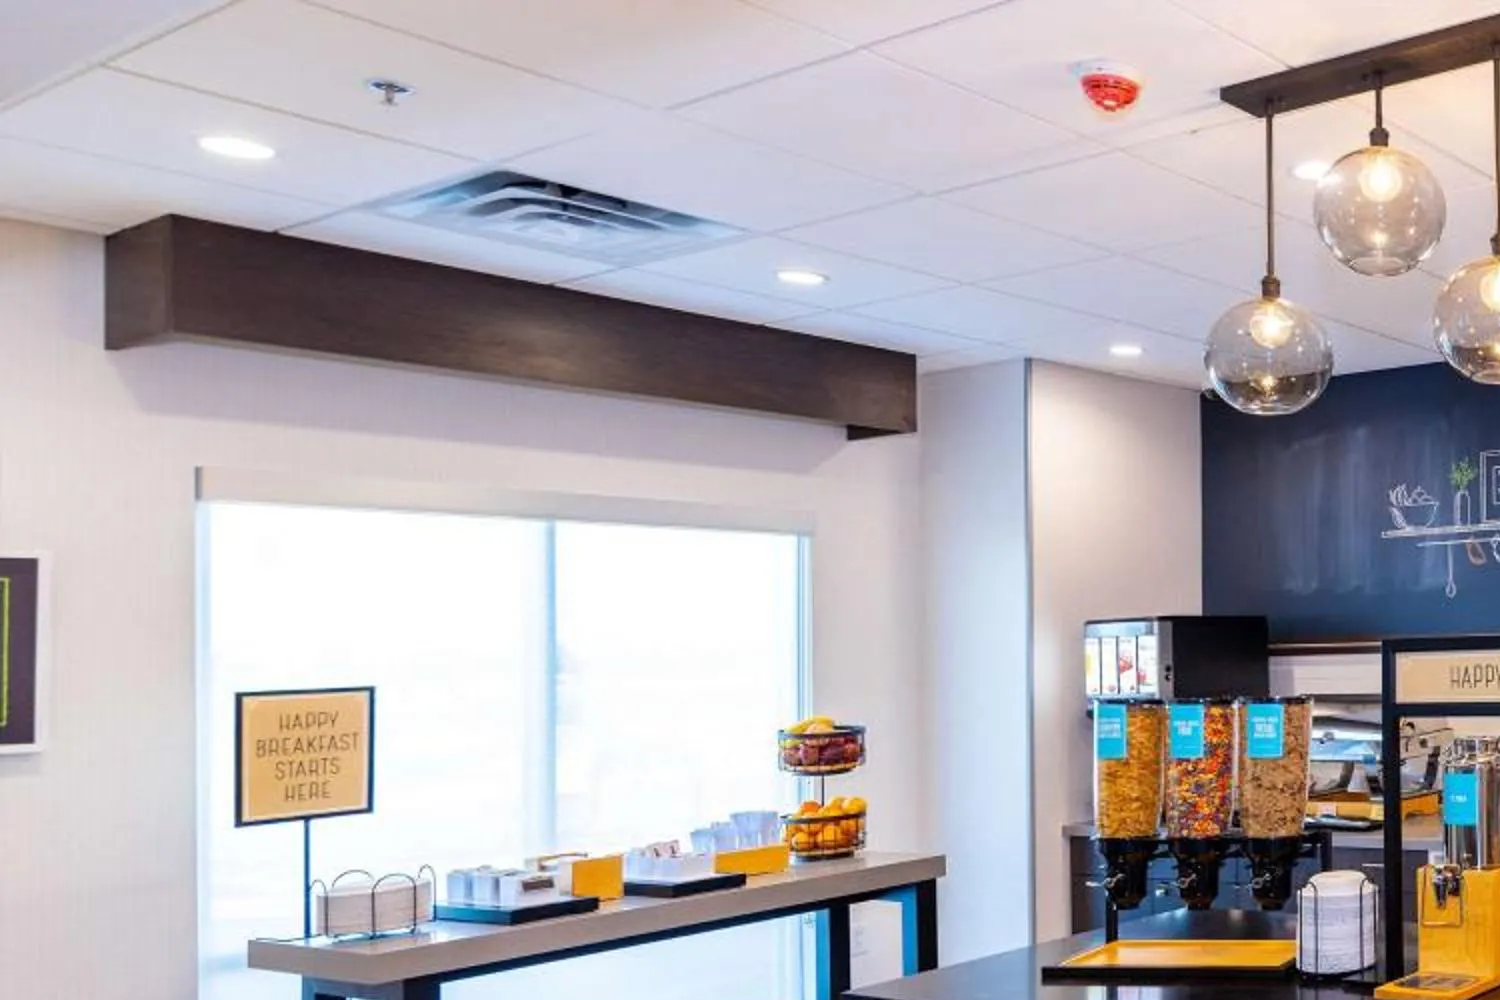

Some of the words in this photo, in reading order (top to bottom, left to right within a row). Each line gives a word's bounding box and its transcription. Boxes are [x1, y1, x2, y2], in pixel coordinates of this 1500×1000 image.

[279, 711, 339, 731] HAPPY
[256, 732, 359, 758] BREAKFAST
[274, 757, 340, 780] STARTS
[284, 780, 332, 801] HERE
